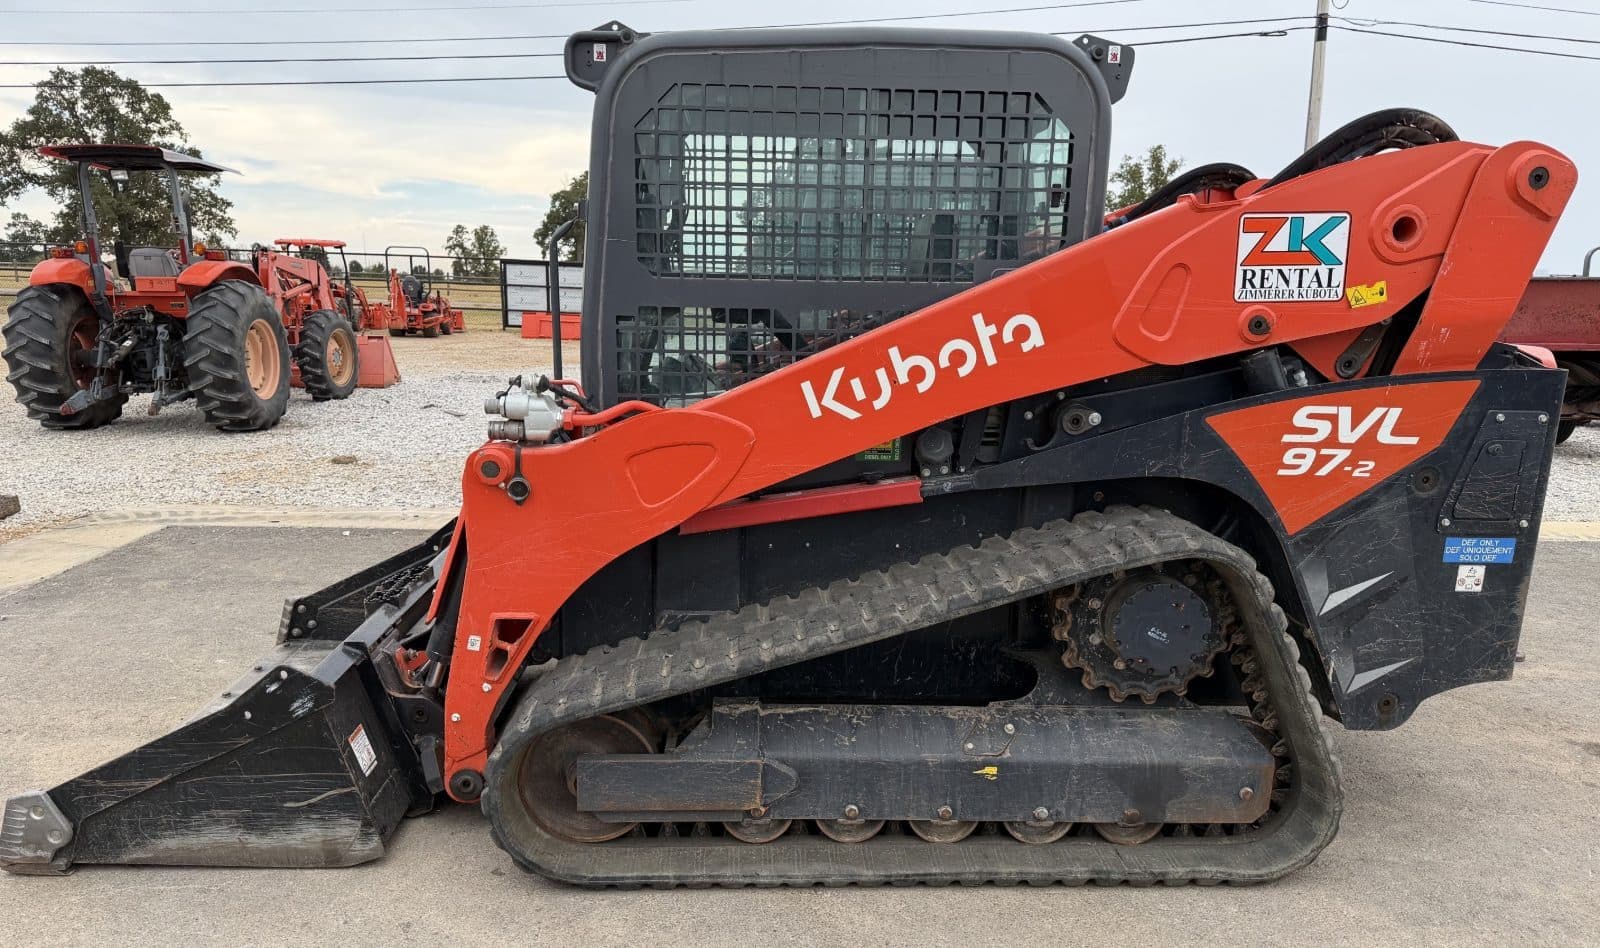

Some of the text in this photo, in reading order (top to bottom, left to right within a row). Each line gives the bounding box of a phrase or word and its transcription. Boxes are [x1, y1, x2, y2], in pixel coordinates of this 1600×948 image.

[1240, 216, 1347, 266] ZK
[1241, 268, 1341, 289] RENTAL
[1237, 288, 1340, 300] ZIMMERER KUBOTA
[800, 312, 1045, 420] Kubota
[1281, 405, 1420, 445] SVL
[1276, 447, 1376, 477] 97-2
[1461, 538, 1500, 546] DEF ONLY
